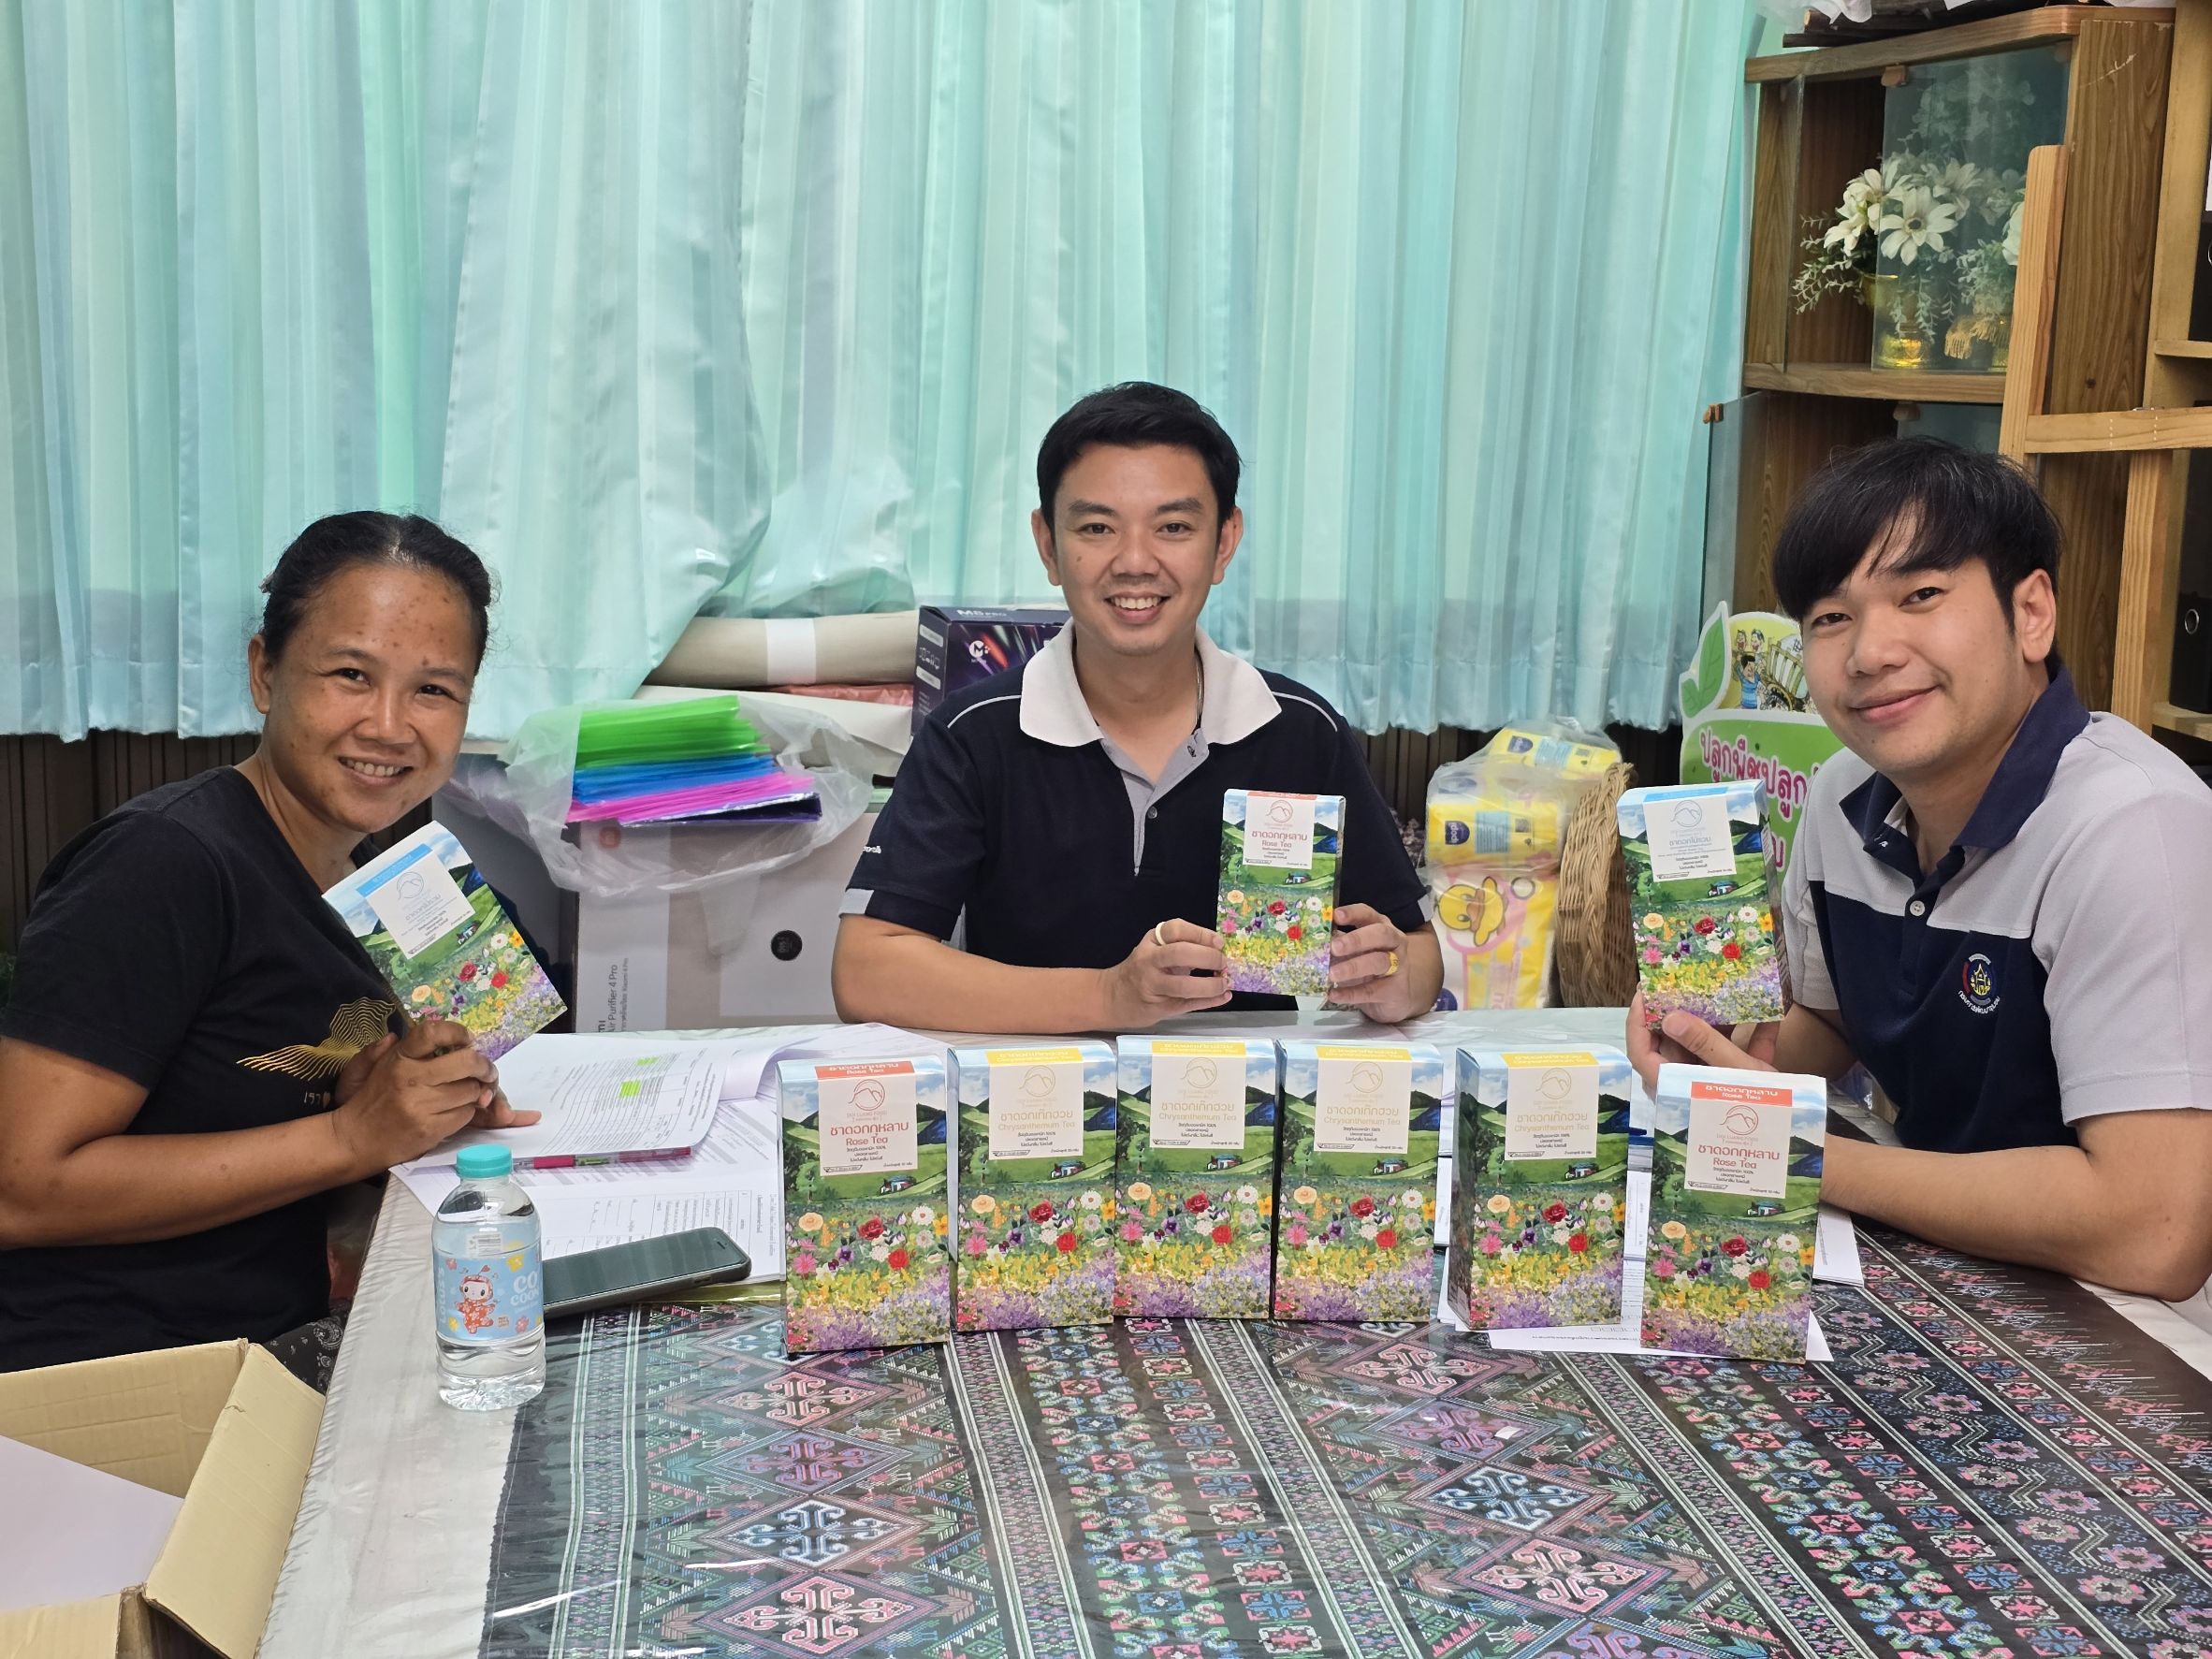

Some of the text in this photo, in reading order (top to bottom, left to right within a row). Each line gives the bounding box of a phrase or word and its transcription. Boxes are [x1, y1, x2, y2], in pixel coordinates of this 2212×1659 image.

[1251, 830, 1308, 842] ชาดอกกุหลาบ
[609, 965, 618, 980] Pro
[607, 988, 618, 1021] Purifier
[1705, 1085, 1778, 1098] ชาดอกกุหลาบ
[997, 1122, 1059, 1131] Chrysanthemum
[1323, 1116, 1385, 1125] Chrysanthemum
[830, 1122, 910, 1137] ชาดอกกุหลาบ
[846, 1136, 888, 1146] Rose Tea
[1697, 1144, 1781, 1160] ชาดอกกุหลาบ
[1712, 1157, 1757, 1170] Rose Tea
